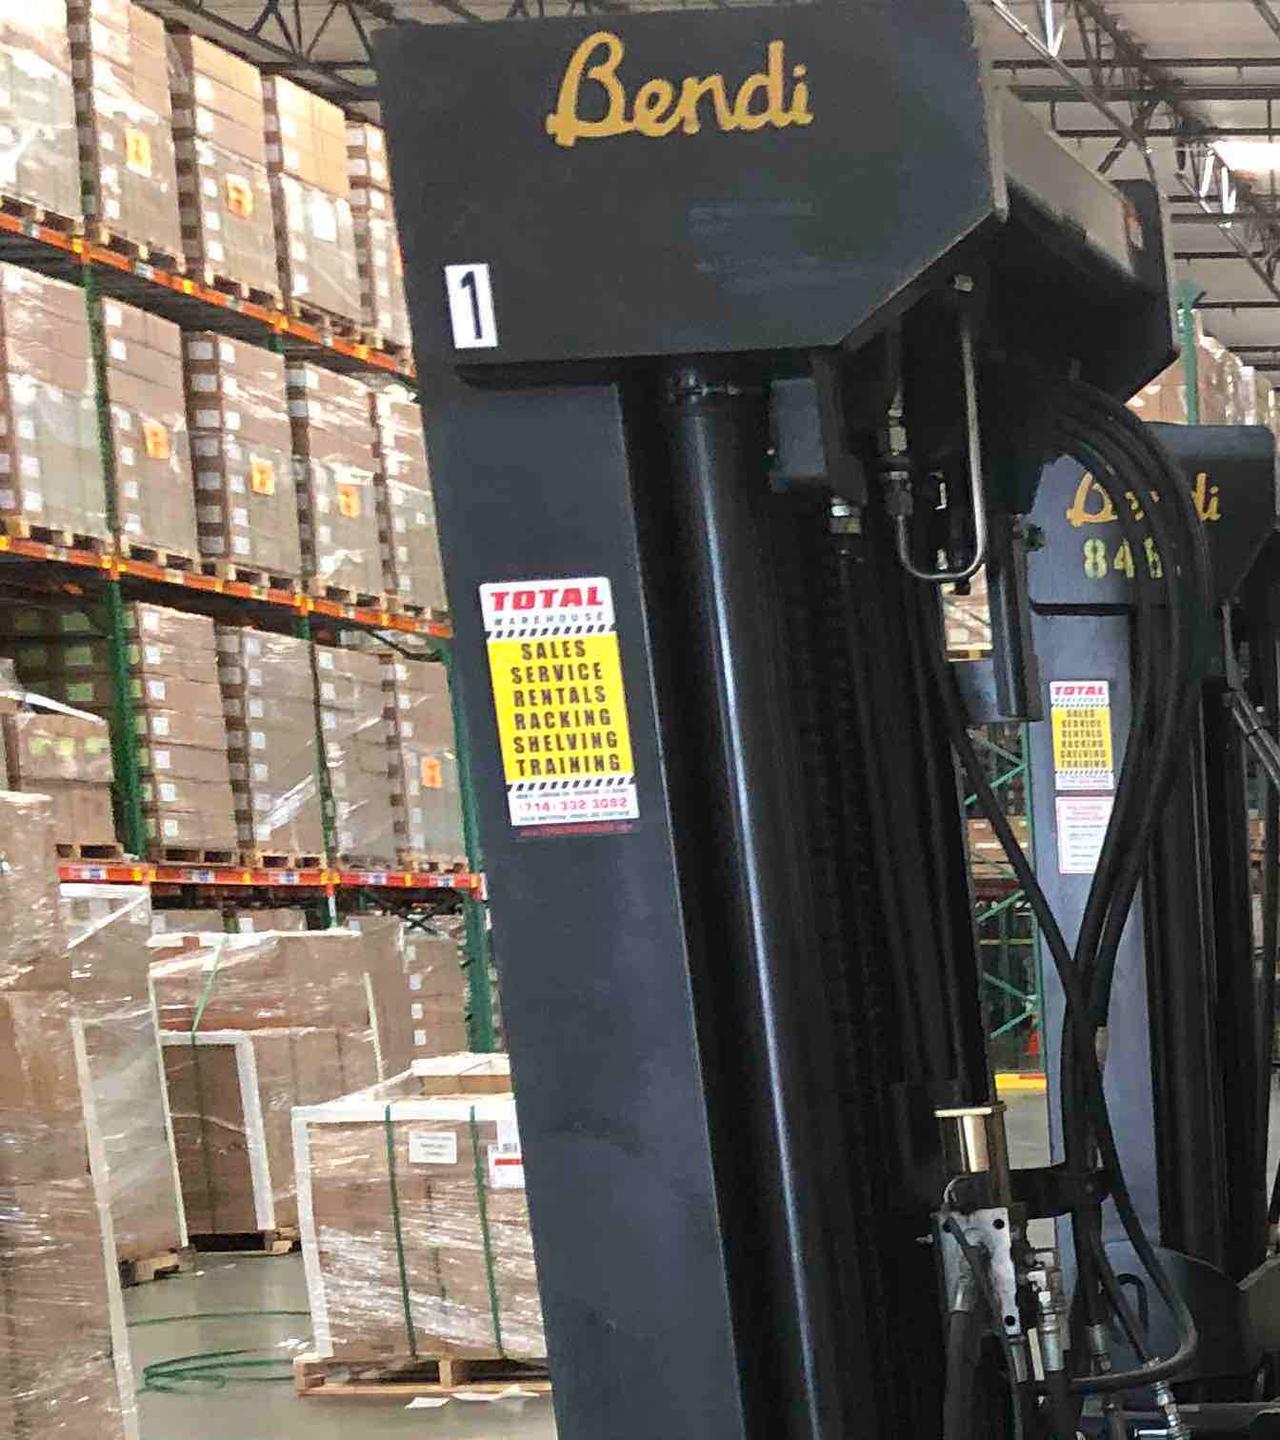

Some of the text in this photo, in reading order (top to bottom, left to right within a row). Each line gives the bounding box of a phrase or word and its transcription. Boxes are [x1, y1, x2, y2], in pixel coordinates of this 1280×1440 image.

[546, 31, 814, 147] Bendi
[461, 271, 482, 340] 1
[490, 586, 604, 612] TOTAL
[494, 611, 605, 626] WAREHOUSE
[521, 639, 586, 660] SALES
[511, 662, 602, 685] SERVICE
[514, 685, 606, 708] RENTALS
[1054, 686, 1105, 696] TOTAL
[514, 707, 612, 731] RACKING
[513, 731, 618, 754] SHELVING
[515, 753, 621, 777] TRAINING
